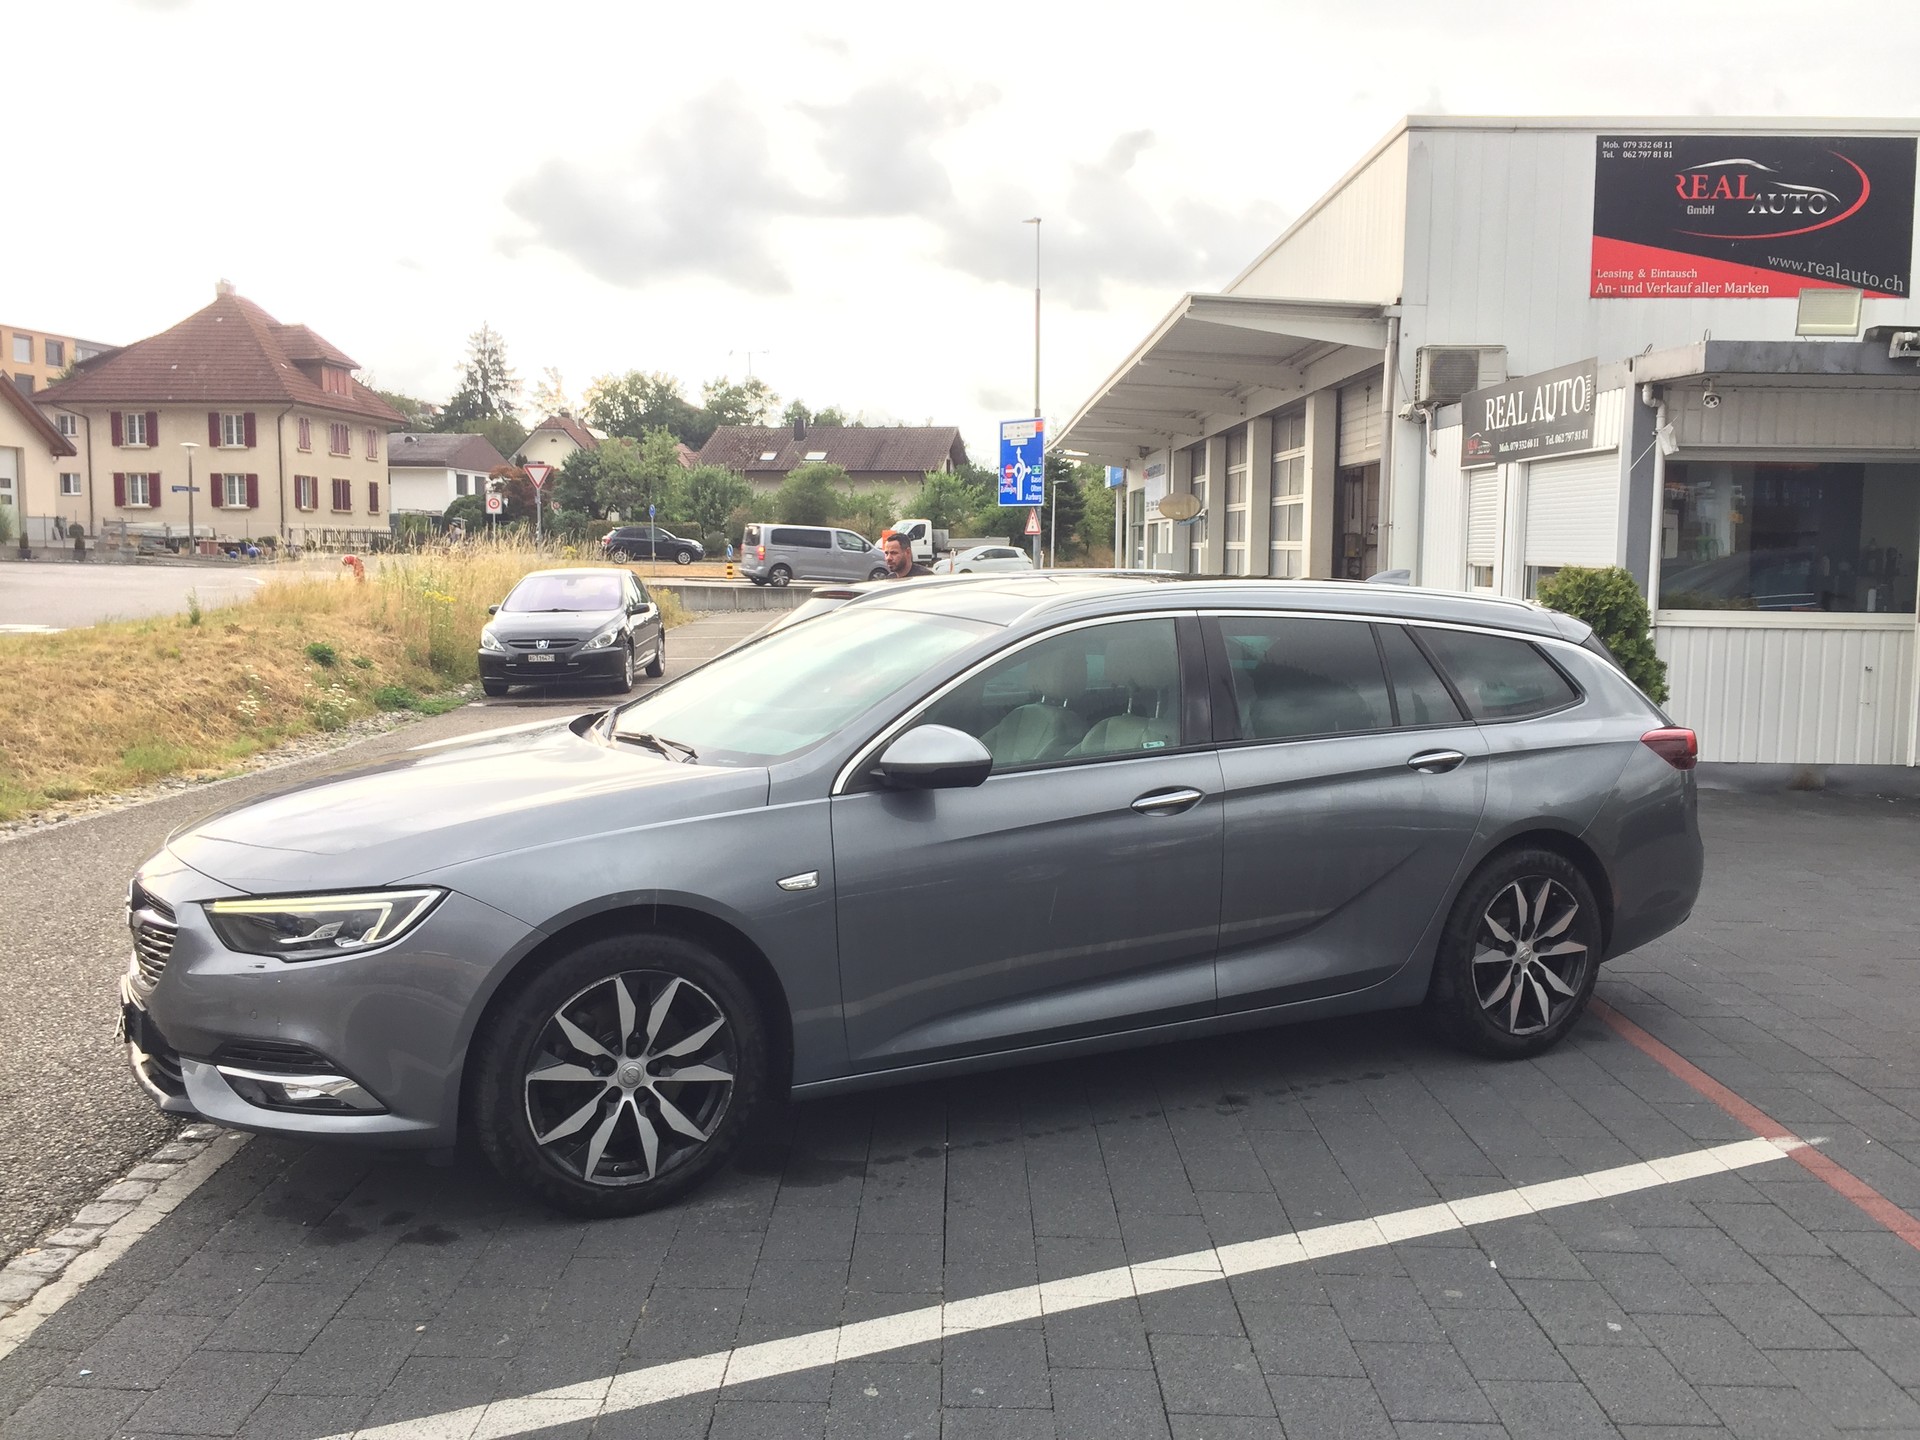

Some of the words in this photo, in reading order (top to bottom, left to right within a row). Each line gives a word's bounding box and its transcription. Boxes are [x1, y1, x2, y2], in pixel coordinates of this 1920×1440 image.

[1602, 141, 1620, 149] Mob.
[1622, 141, 1637, 149] 079
[1638, 141, 1652, 149] 332
[1653, 141, 1663, 149] 68
[1664, 141, 1673, 149] 11
[1675, 174, 1756, 199] REAL
[1686, 205, 1715, 215] GmbH
[1748, 193, 1828, 215] AUTO
[1597, 269, 1634, 280] Leasing
[1637, 269, 1646, 278] &
[1651, 269, 1698, 278] Eintausch
[1767, 254, 1904, 292] www.realauto.ch
[1595, 282, 1617, 294] An-
[1620, 282, 1643, 294] und
[1646, 282, 1694, 294] Verkauf
[1694, 282, 1722, 294] aller
[1724, 282, 1770, 294] Marken
[1485, 391, 1528, 431] REAL
[1531, 375, 1586, 422] AUTO
